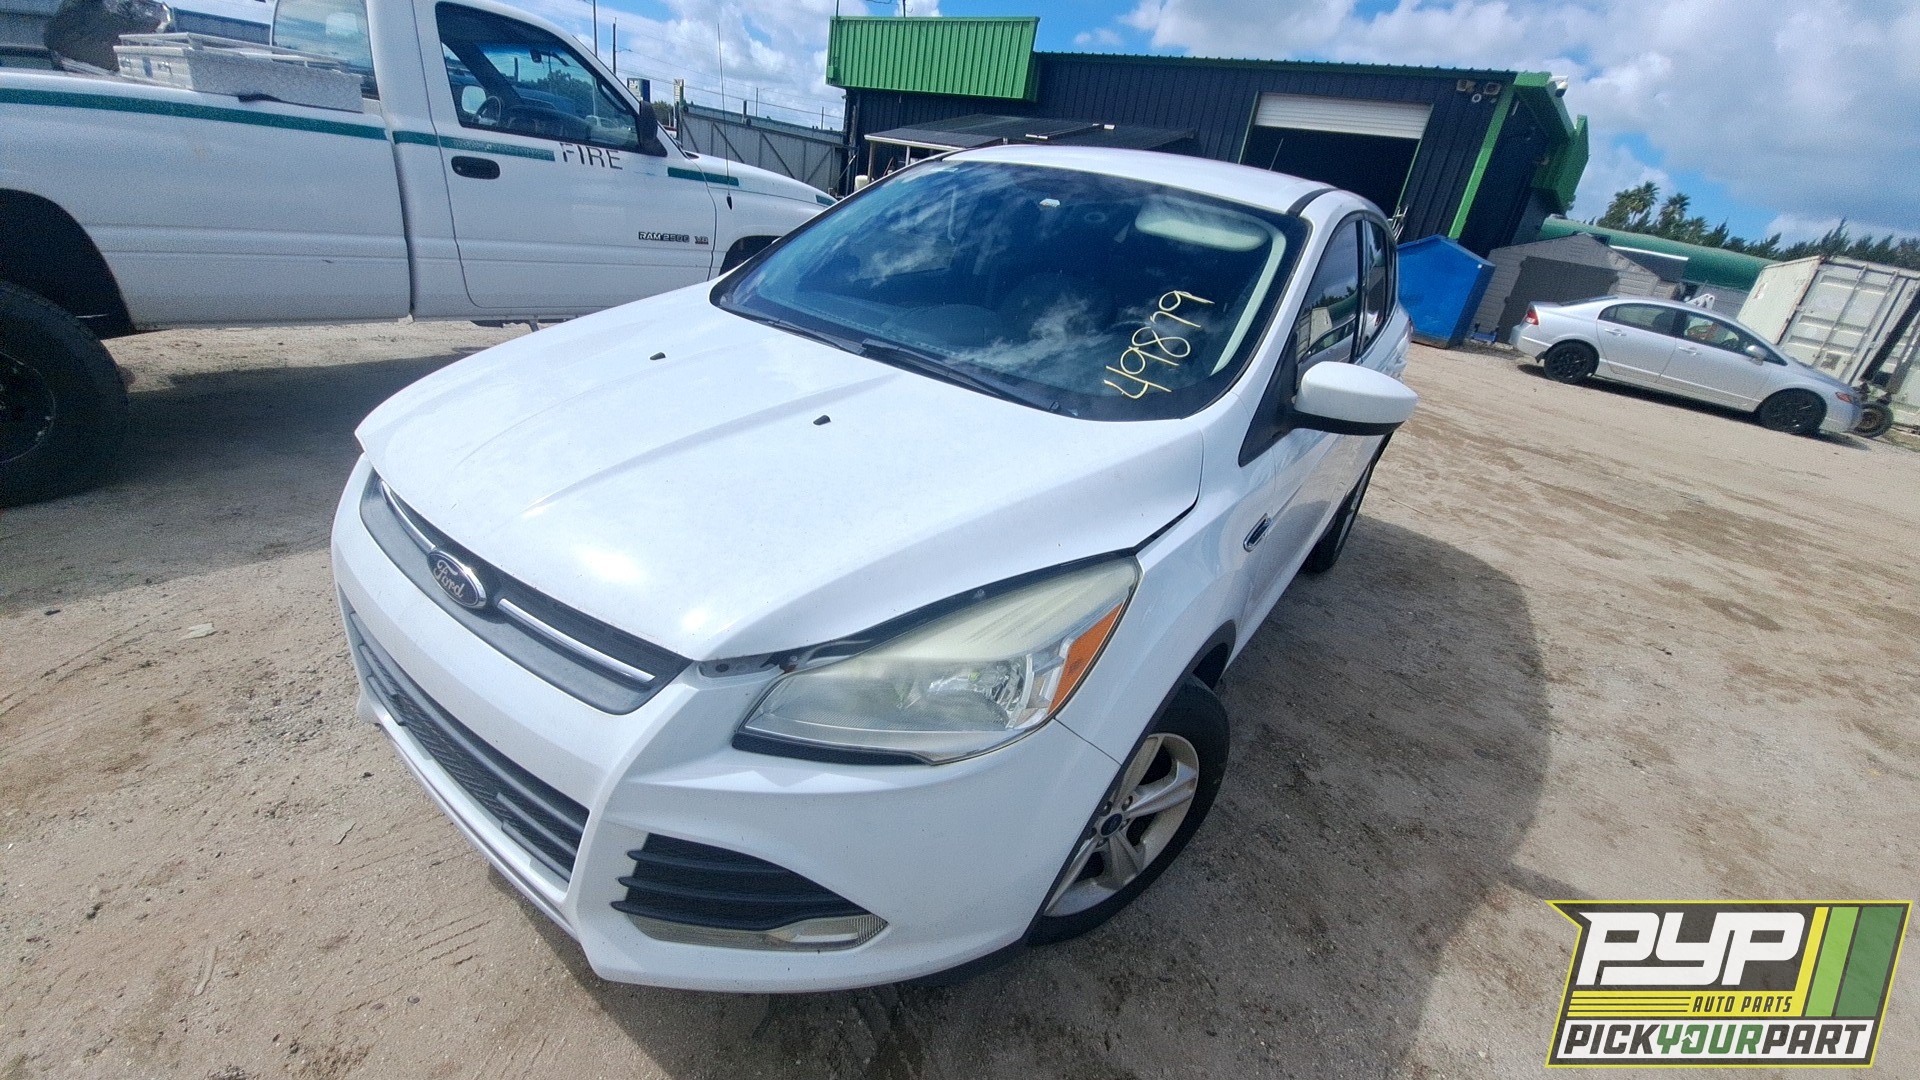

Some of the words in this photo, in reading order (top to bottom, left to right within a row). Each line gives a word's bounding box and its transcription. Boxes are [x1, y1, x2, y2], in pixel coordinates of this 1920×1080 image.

[559, 142, 623, 170] FIRE
[638, 231, 661, 241] RAM
[1103, 290, 1216, 399] 49879
[433, 559, 466, 598] Ford
